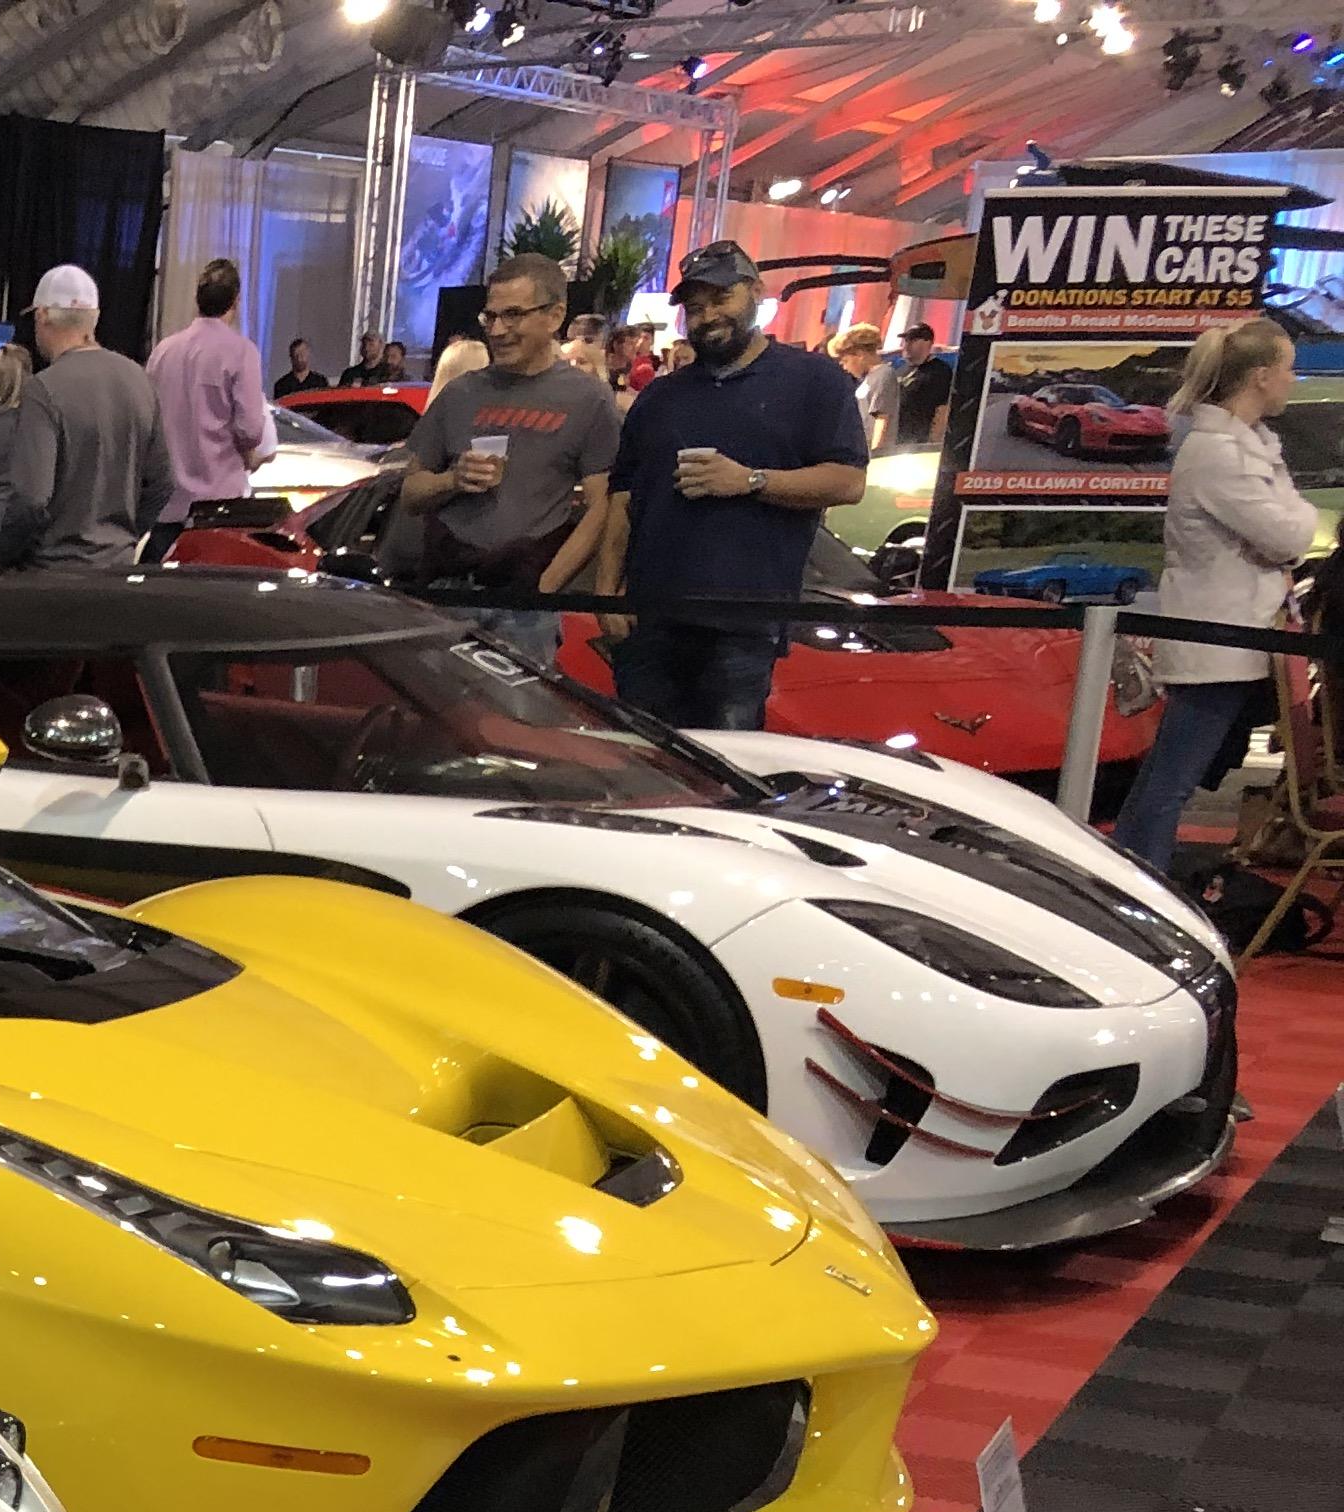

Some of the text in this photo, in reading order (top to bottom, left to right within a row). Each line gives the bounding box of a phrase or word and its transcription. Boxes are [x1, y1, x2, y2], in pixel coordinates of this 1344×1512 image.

[1163, 215, 1270, 242] THESE
[992, 215, 1158, 284] WIN
[1155, 246, 1261, 284] CARS
[1011, 288, 1254, 307] DONATIONS START AT $5
[1125, 313, 1197, 328] McDonald
[963, 476, 1168, 490] 2019 CALLAWAY CORVETTE
